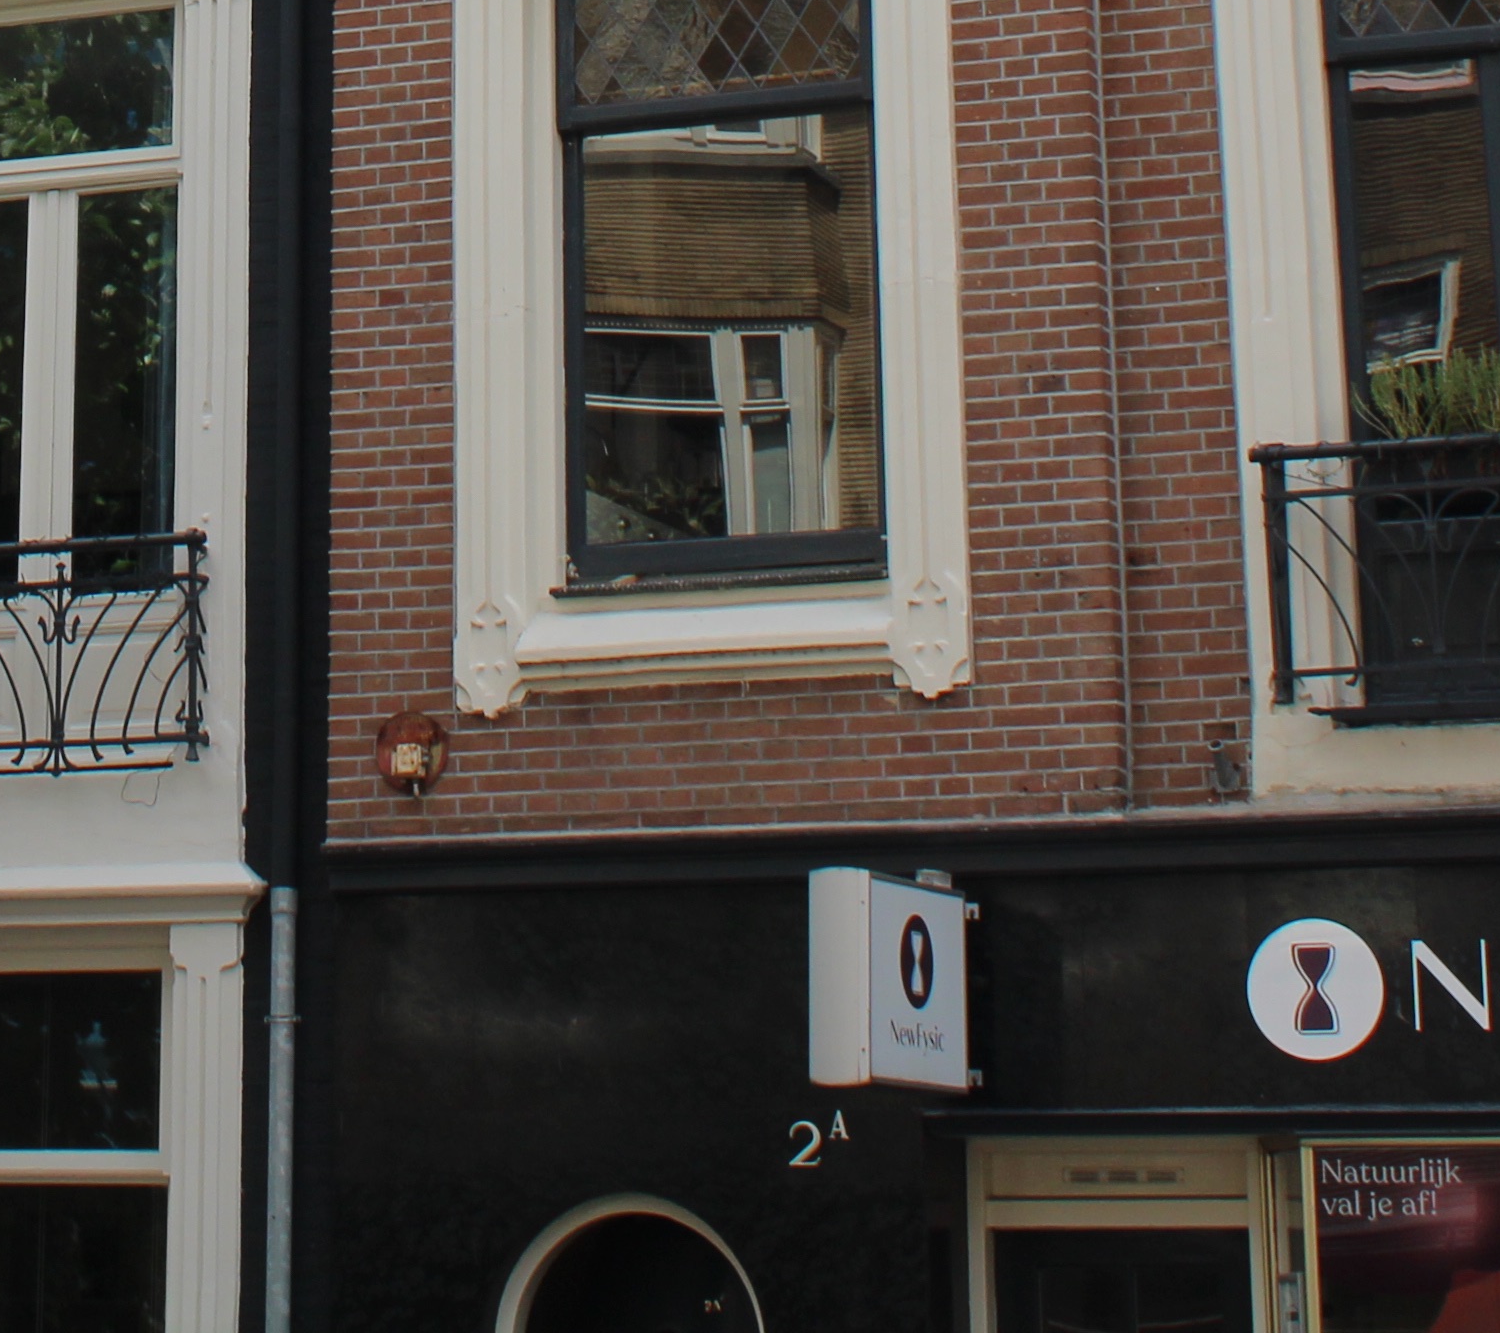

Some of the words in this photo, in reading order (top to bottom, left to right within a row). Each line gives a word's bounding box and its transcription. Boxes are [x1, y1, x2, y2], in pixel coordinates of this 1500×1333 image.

[890, 1018, 945, 1056] NewFysic
[1321, 1157, 1463, 1188] Natuurlijk
[1321, 1190, 1361, 1215] val
[1368, 1191, 1393, 1221] je
[1401, 1190, 1438, 1215] af!
